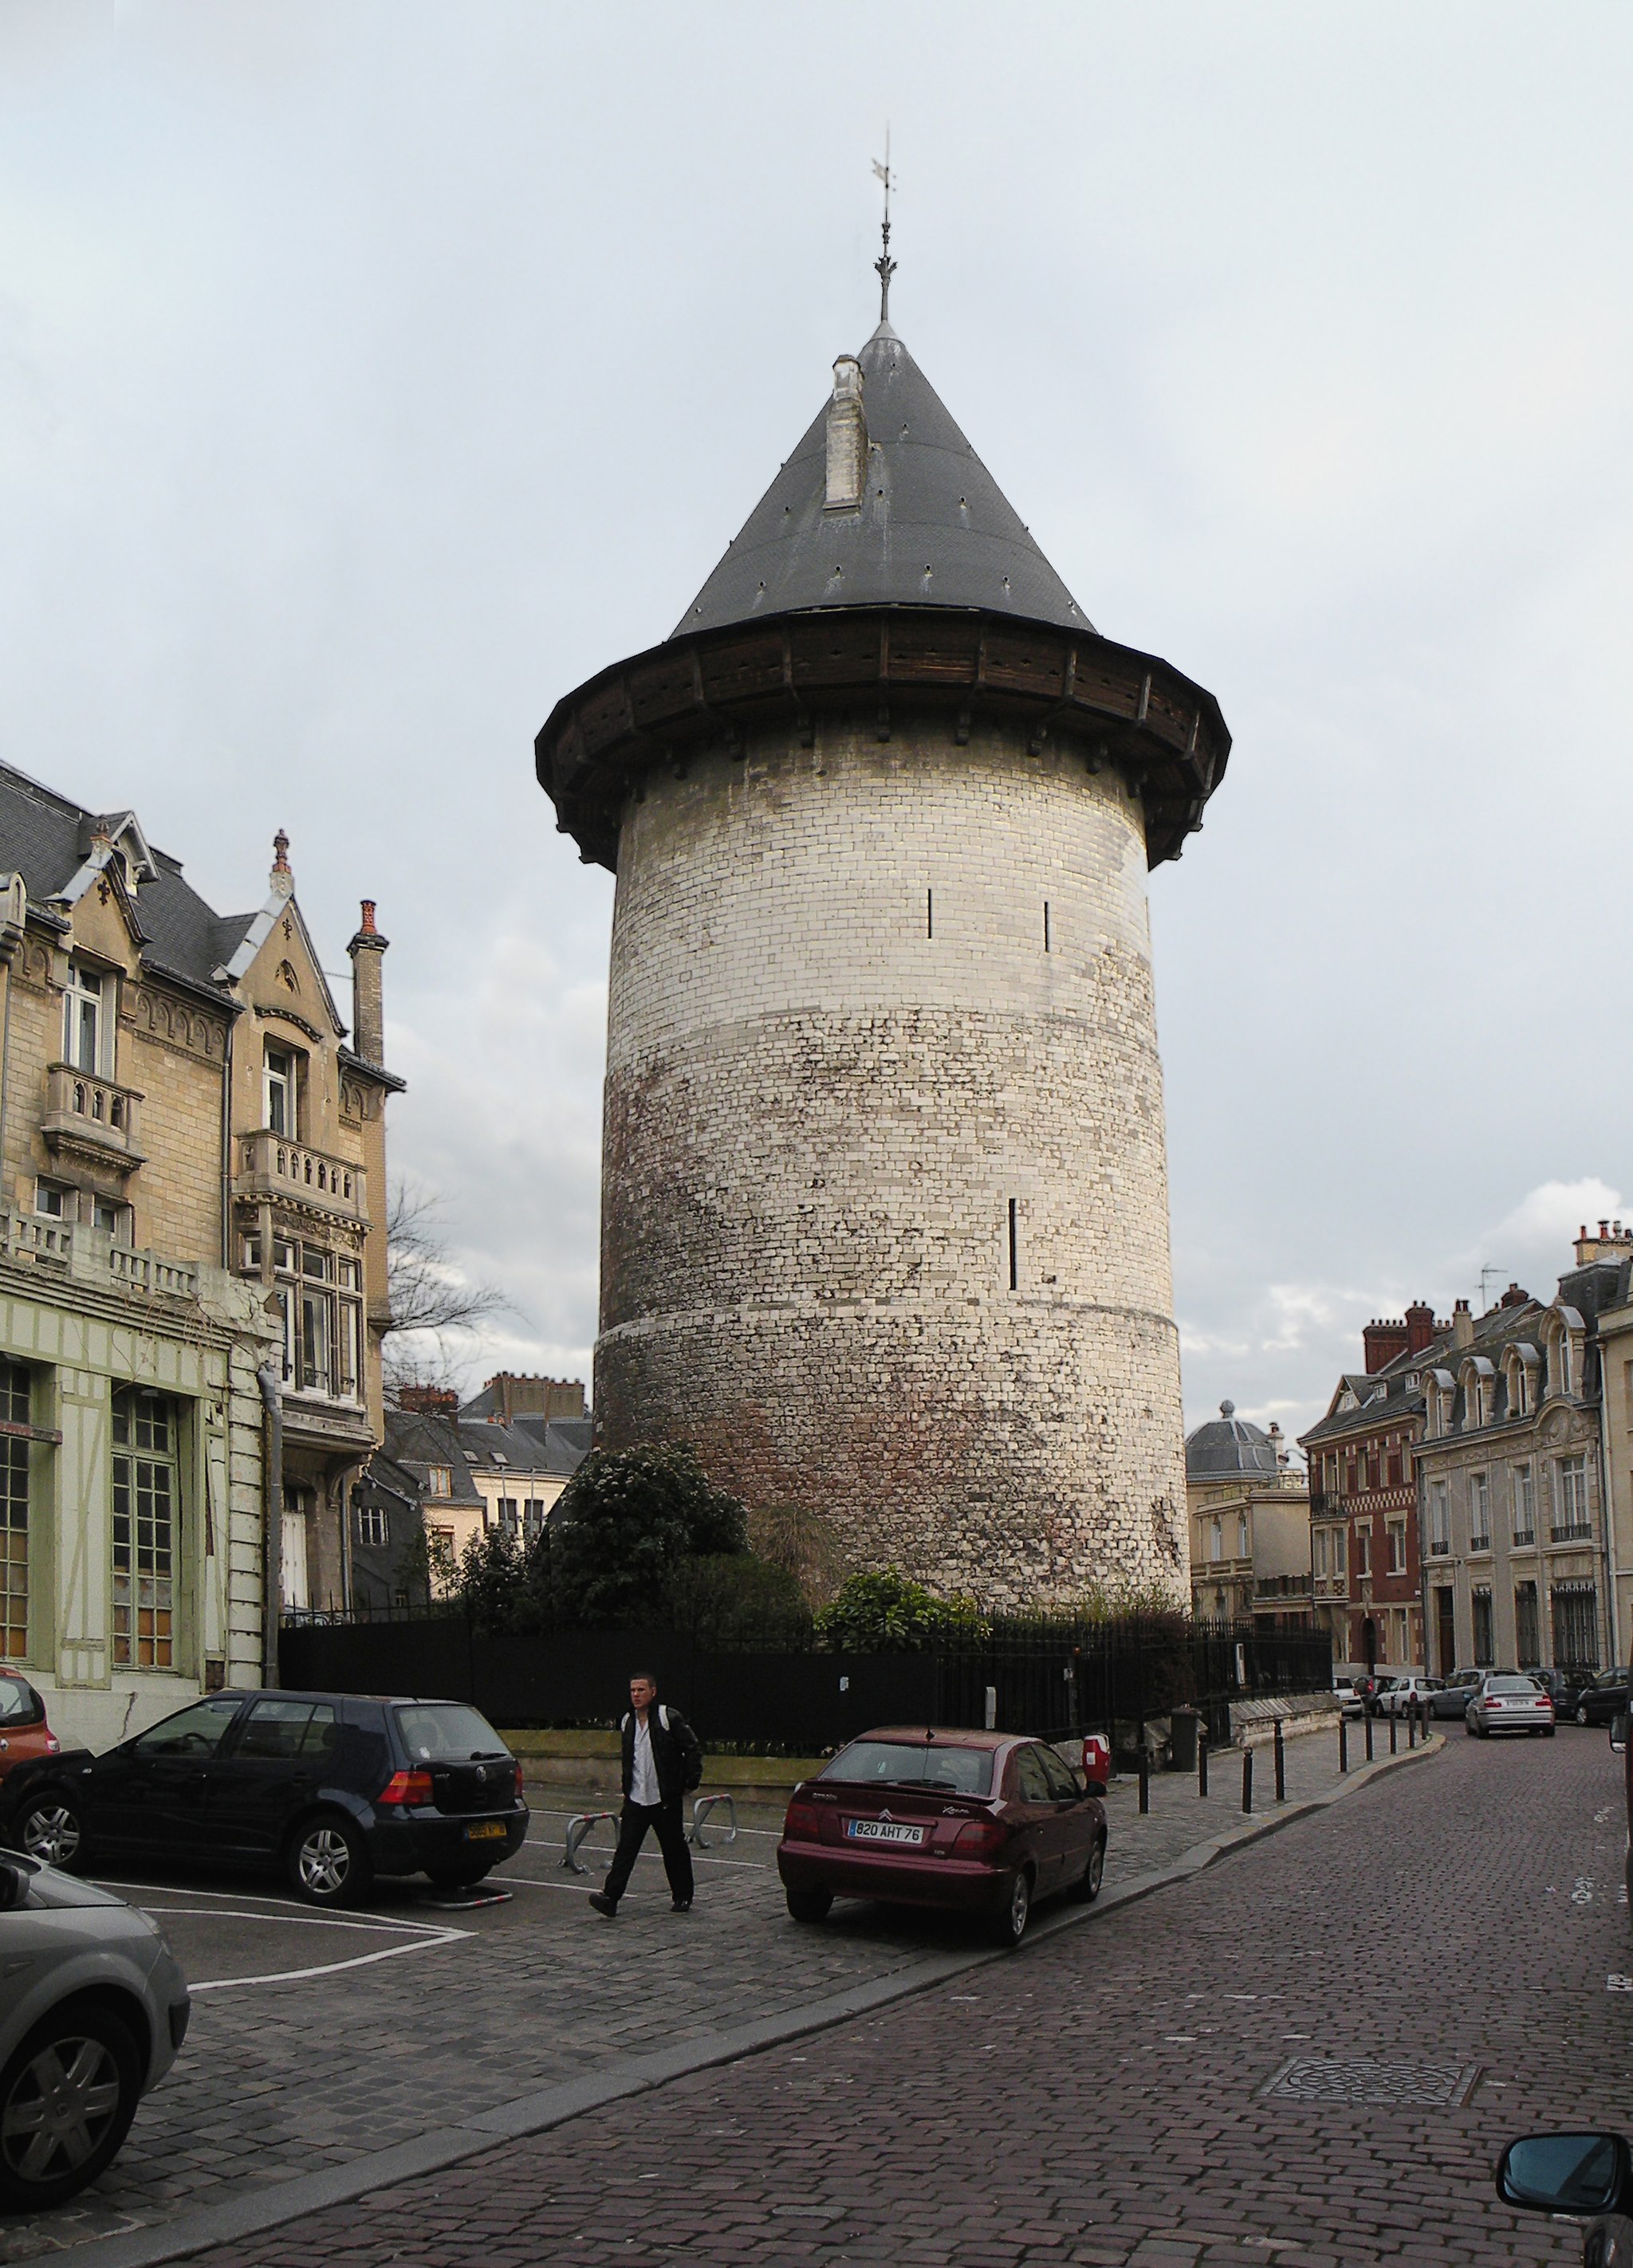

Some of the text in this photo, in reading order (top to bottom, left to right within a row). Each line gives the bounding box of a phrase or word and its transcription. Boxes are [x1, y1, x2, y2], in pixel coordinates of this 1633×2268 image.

[856, 1822, 920, 1841] 820 AHT 76
